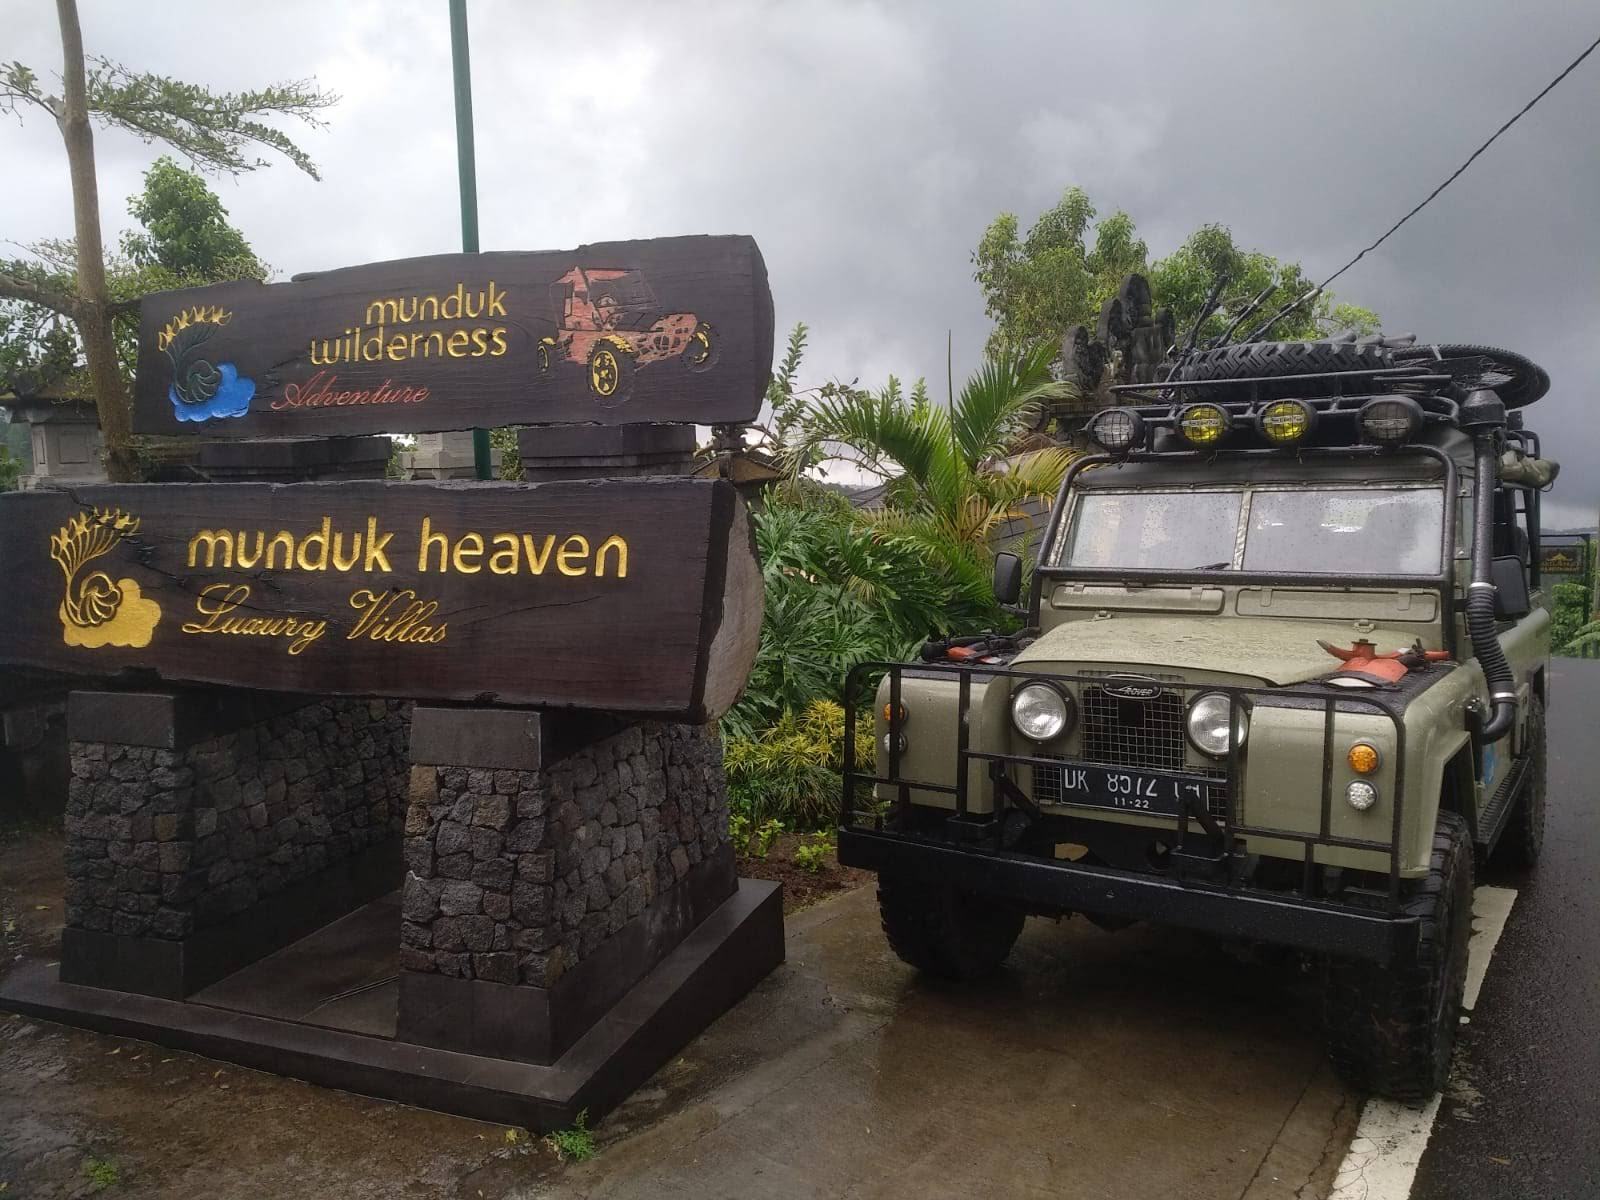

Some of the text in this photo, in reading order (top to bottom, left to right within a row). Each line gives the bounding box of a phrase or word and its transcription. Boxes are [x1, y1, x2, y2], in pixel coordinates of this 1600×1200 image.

[365, 281, 507, 326] munduk
[311, 325, 508, 366] wilderness
[270, 369, 430, 411] Adventure
[187, 516, 628, 579] munduk heaven
[181, 583, 448, 656] Luxury Villas
